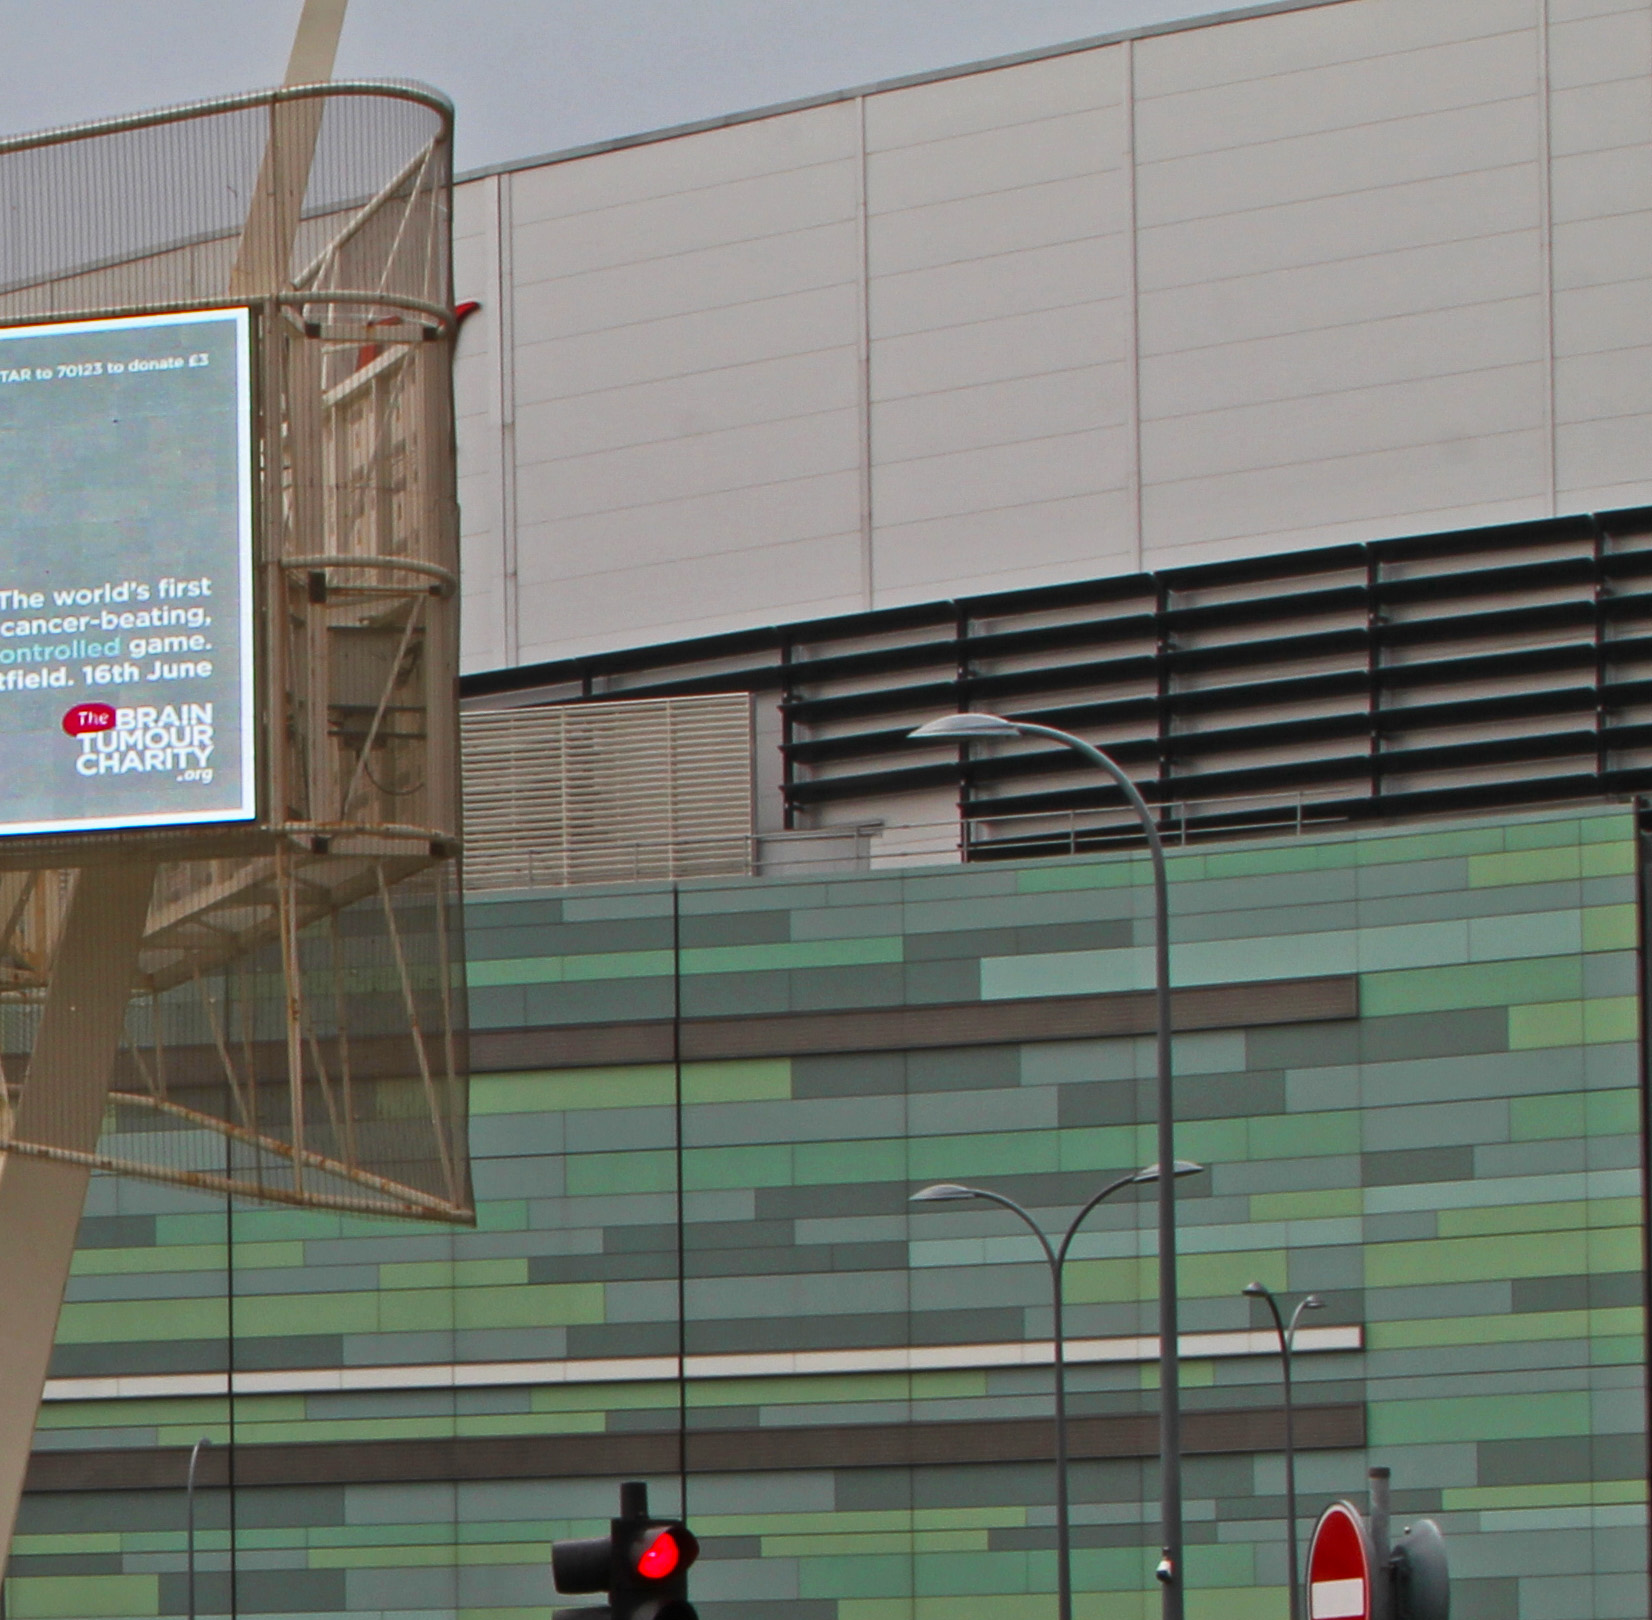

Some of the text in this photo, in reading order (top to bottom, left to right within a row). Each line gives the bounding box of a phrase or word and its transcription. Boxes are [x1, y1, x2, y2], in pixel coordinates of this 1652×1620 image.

[35, 366, 53, 380] to
[57, 362, 103, 379] 70123
[107, 360, 125, 374] to
[128, 355, 184, 373] donate
[188, 352, 210, 368] £3
[52, 582, 150, 607] world's
[158, 577, 212, 599] first
[0, 606, 212, 638] cancer-beating,
[128, 634, 212, 659] game.
[82, 662, 139, 685] 16th
[146, 660, 213, 682] June
[77, 702, 213, 730] The BRAIN
[76, 725, 214, 753] TUMOUR
[76, 745, 215, 776] CHARITY
[176, 768, 214, 784] .org
